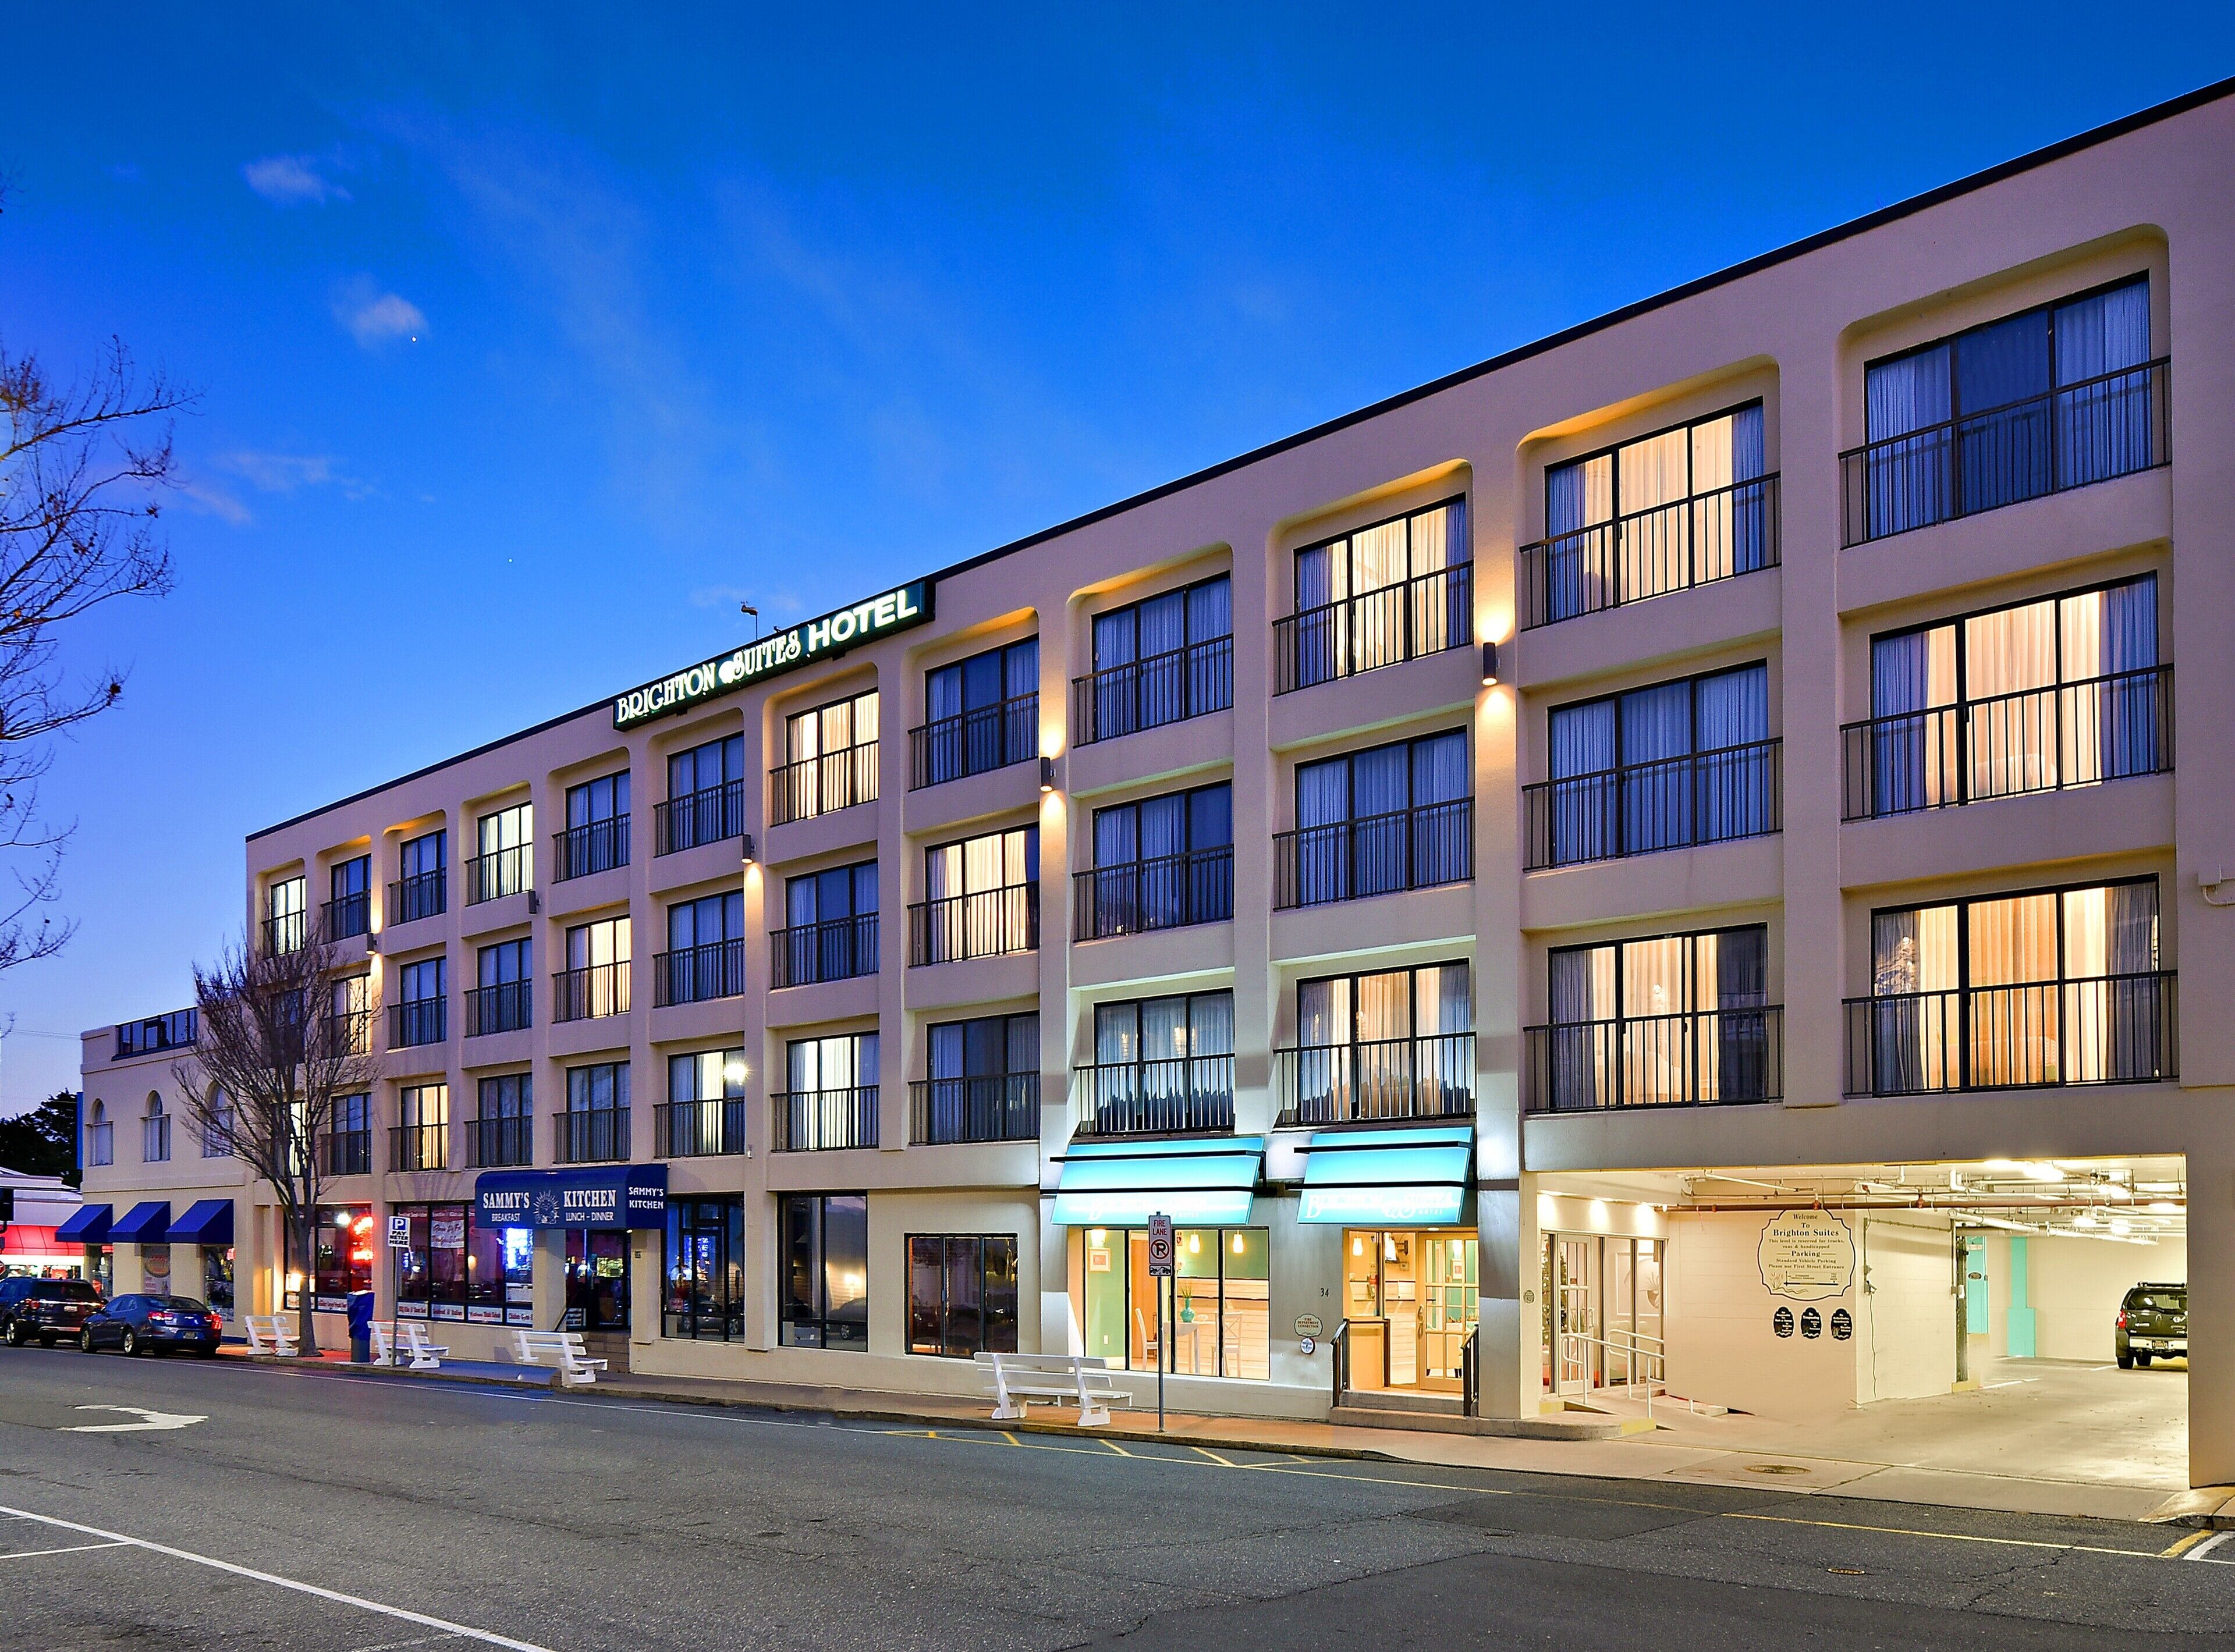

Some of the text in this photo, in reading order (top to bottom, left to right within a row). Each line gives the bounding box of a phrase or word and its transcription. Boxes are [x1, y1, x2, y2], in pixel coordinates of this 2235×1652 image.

[616, 589, 918, 723] BRIGHTON SUITES HOTEL
[629, 1187, 664, 1196] SAMMY'S
[483, 1190, 616, 1209] SAMMY'S KITCHEN
[629, 1200, 664, 1209] KITCHEN
[491, 1213, 520, 1221] BREAKFAST
[566, 1213, 585, 1221] LUNCH
[591, 1212, 614, 1220] DINNER
[395, 1219, 404, 1229] P
[1773, 1229, 1810, 1237] Brighton
[1320, 1288, 1329, 1297] 34
